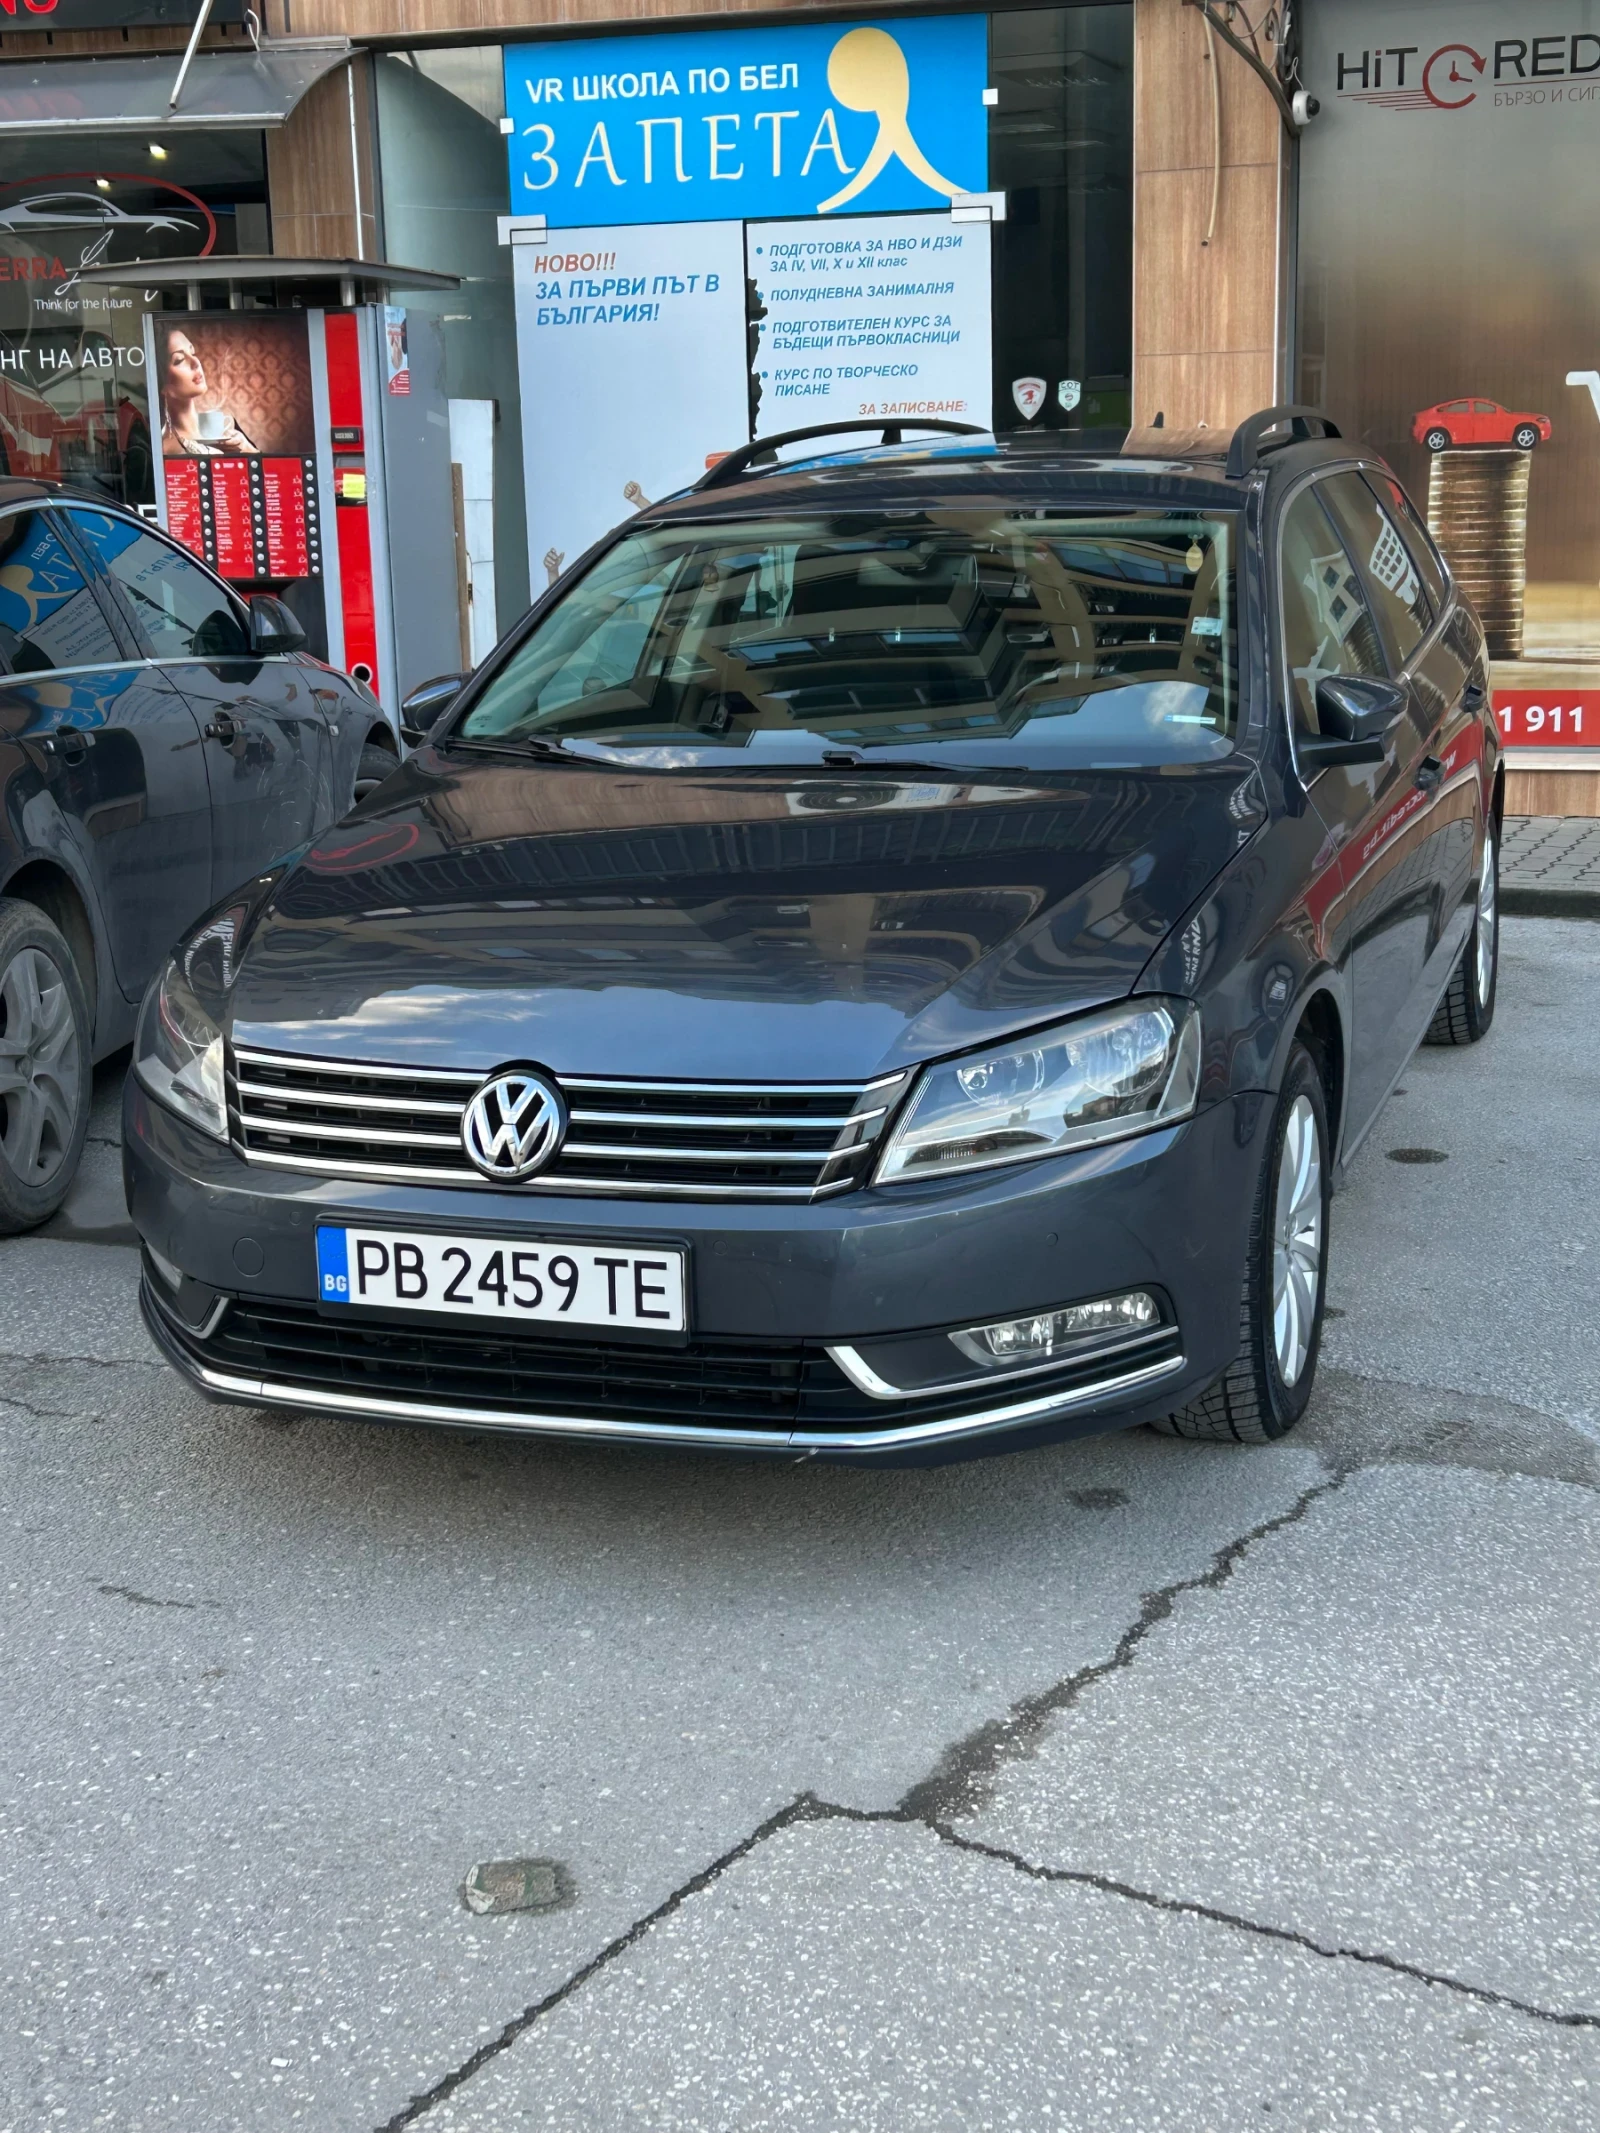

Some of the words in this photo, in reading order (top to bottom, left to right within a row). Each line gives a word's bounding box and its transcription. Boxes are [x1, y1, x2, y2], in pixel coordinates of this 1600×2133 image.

[526, 78, 564, 104] VR
[573, 70, 679, 101] ШКОЛА
[689, 67, 730, 94] ПО
[739, 63, 798, 91] БЕЛ
[1494, 90, 1546, 106] БЪРЗО
[1551, 88, 1563, 103] И
[769, 241, 861, 257] ПОДГОТОВКА
[866, 239, 883, 251] ЗА
[888, 238, 917, 250] НВО
[920, 237, 931, 249] И
[933, 236, 963, 250] ДЗИ
[534, 252, 616, 274] НОВО!!!
[770, 260, 787, 272] ЗА
[877, 257, 908, 268] клас
[536, 281, 562, 300] ЗА
[569, 276, 646, 298] ПЪРВИ
[652, 275, 700, 295] ПЪТ
[705, 274, 719, 292] В
[771, 286, 863, 302] ПОЛУДНЕВНА
[867, 282, 954, 297] ЗАНИМАЛНЯ
[34, 299, 62, 311] Think
[65, 298, 79, 312] for
[82, 298, 100, 310] the
[102, 298, 133, 311] future
[537, 303, 660, 326] БЪЛГАРИЯ!
[773, 318, 891, 335] ПОДГОТВИТЕЛЕН
[894, 315, 930, 329] КУРС
[934, 315, 951, 326] ЗА
[773, 335, 833, 351] БЪДЕЩИ
[837, 330, 960, 346] ПЪРВОКЛАСНИЦИ
[39, 349, 74, 369] НА
[82, 346, 145, 368] АВТО
[775, 368, 809, 381] КУРС
[813, 367, 832, 379] ПО
[837, 364, 918, 378] ТВОРЧЕСКО
[775, 383, 831, 397] ПИСАНЕ
[859, 403, 876, 415] ЗА
[880, 400, 968, 415] ЗАПИСВАНЕ:
[1525, 705, 1582, 732] 911
[324, 1274, 348, 1293] BG
[356, 1239, 428, 1299] PB
[441, 1247, 580, 1312] 2459
[593, 1257, 671, 1319] TE
